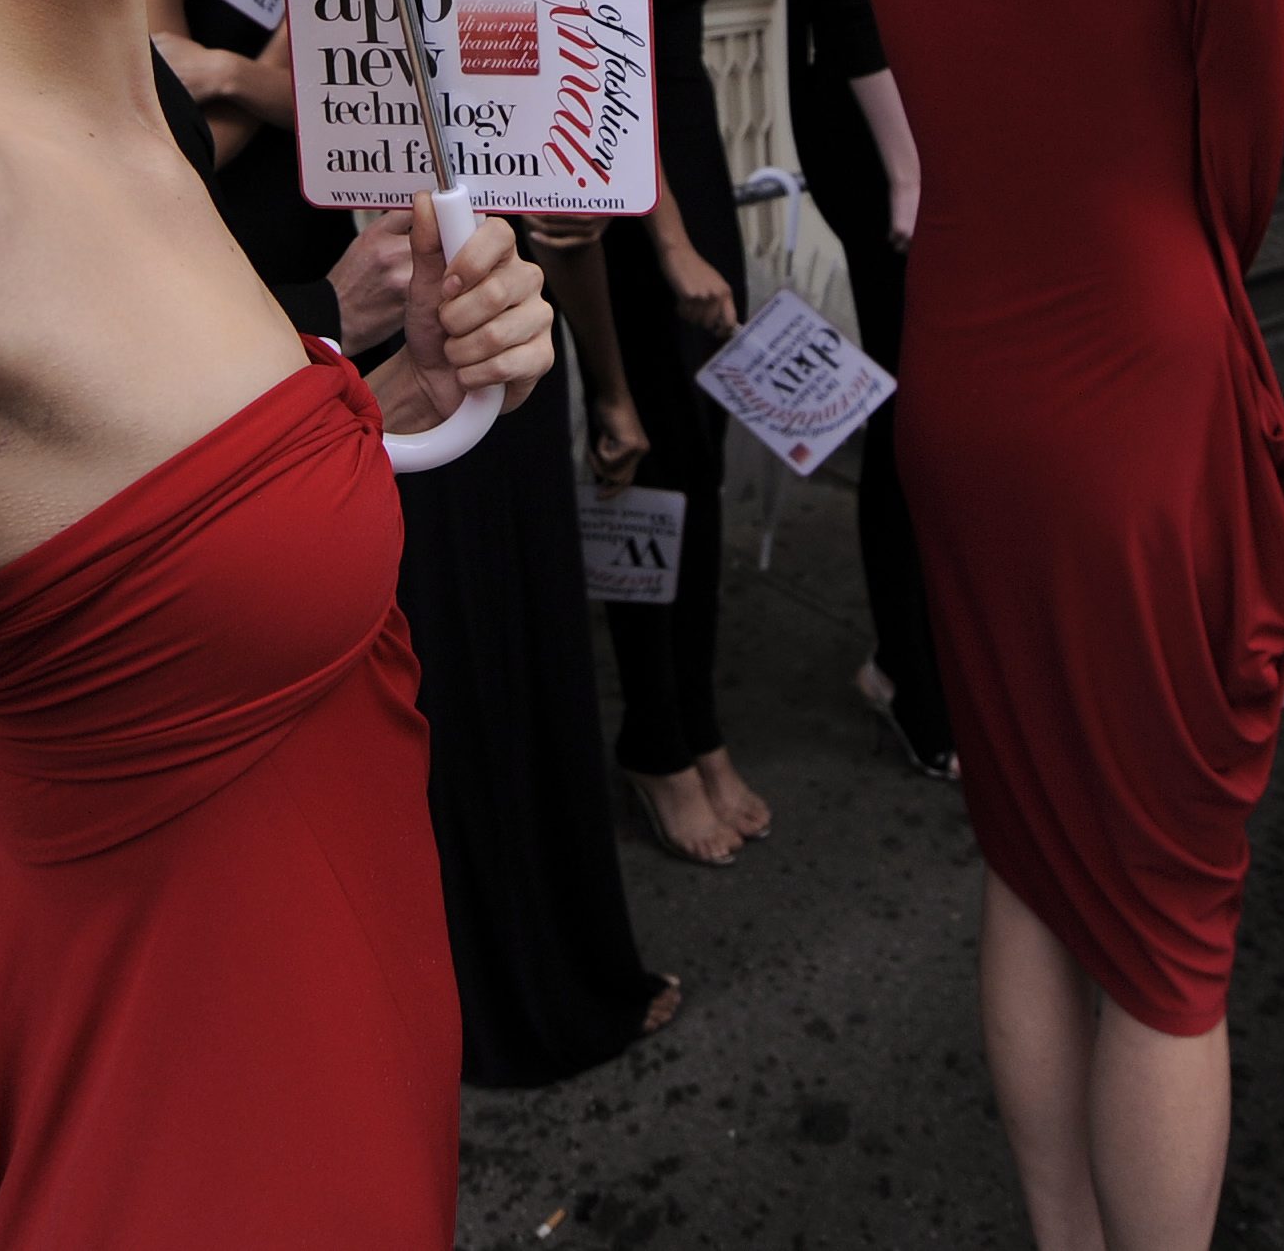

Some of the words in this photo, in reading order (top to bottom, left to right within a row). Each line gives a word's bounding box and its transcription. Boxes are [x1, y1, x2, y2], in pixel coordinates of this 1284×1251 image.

[580, 1, 646, 48] of
[318, 47, 445, 87] new
[321, 90, 516, 138] technlogy
[585, 26, 647, 171] fashion
[326, 139, 395, 173] and
